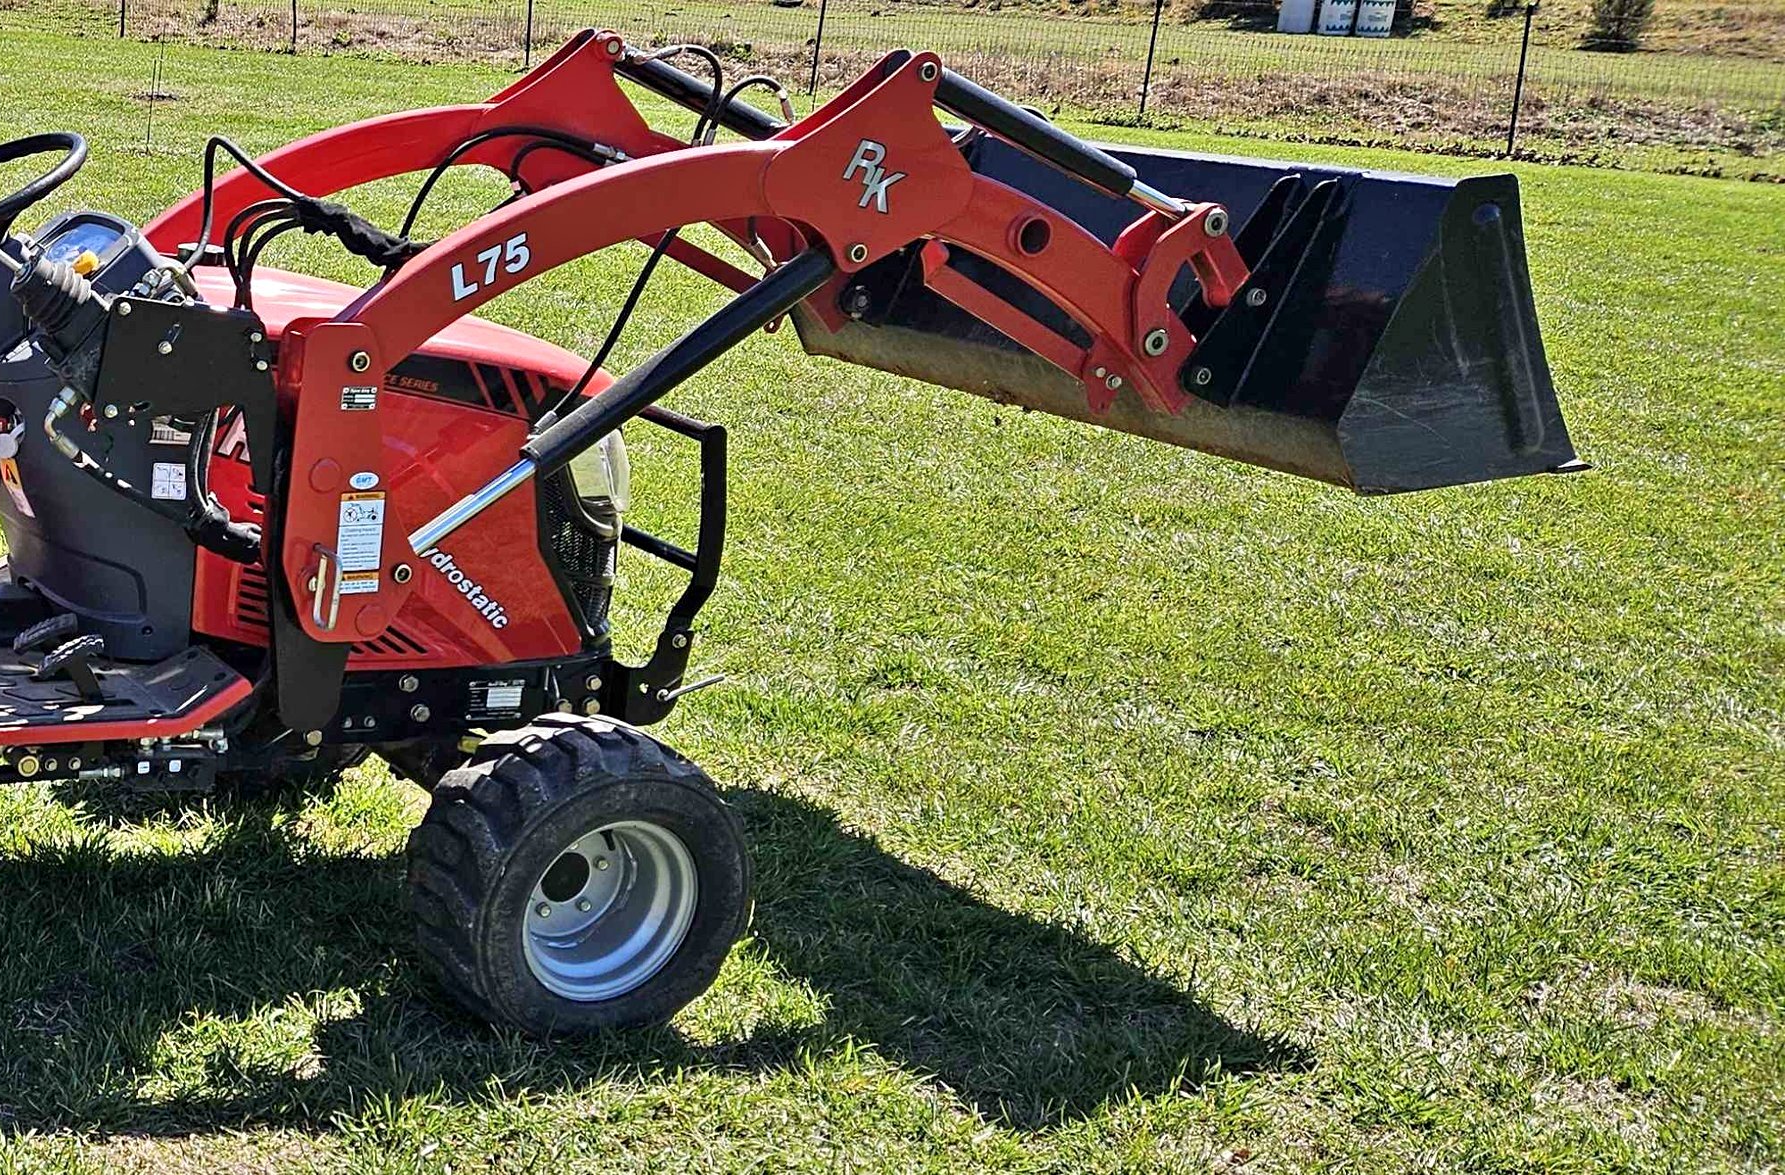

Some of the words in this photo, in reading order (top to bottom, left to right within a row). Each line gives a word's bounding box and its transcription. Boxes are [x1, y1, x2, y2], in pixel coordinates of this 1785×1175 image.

[842, 138, 909, 214] RK
[451, 232, 531, 302] L75
[399, 376, 439, 392] SERIES
